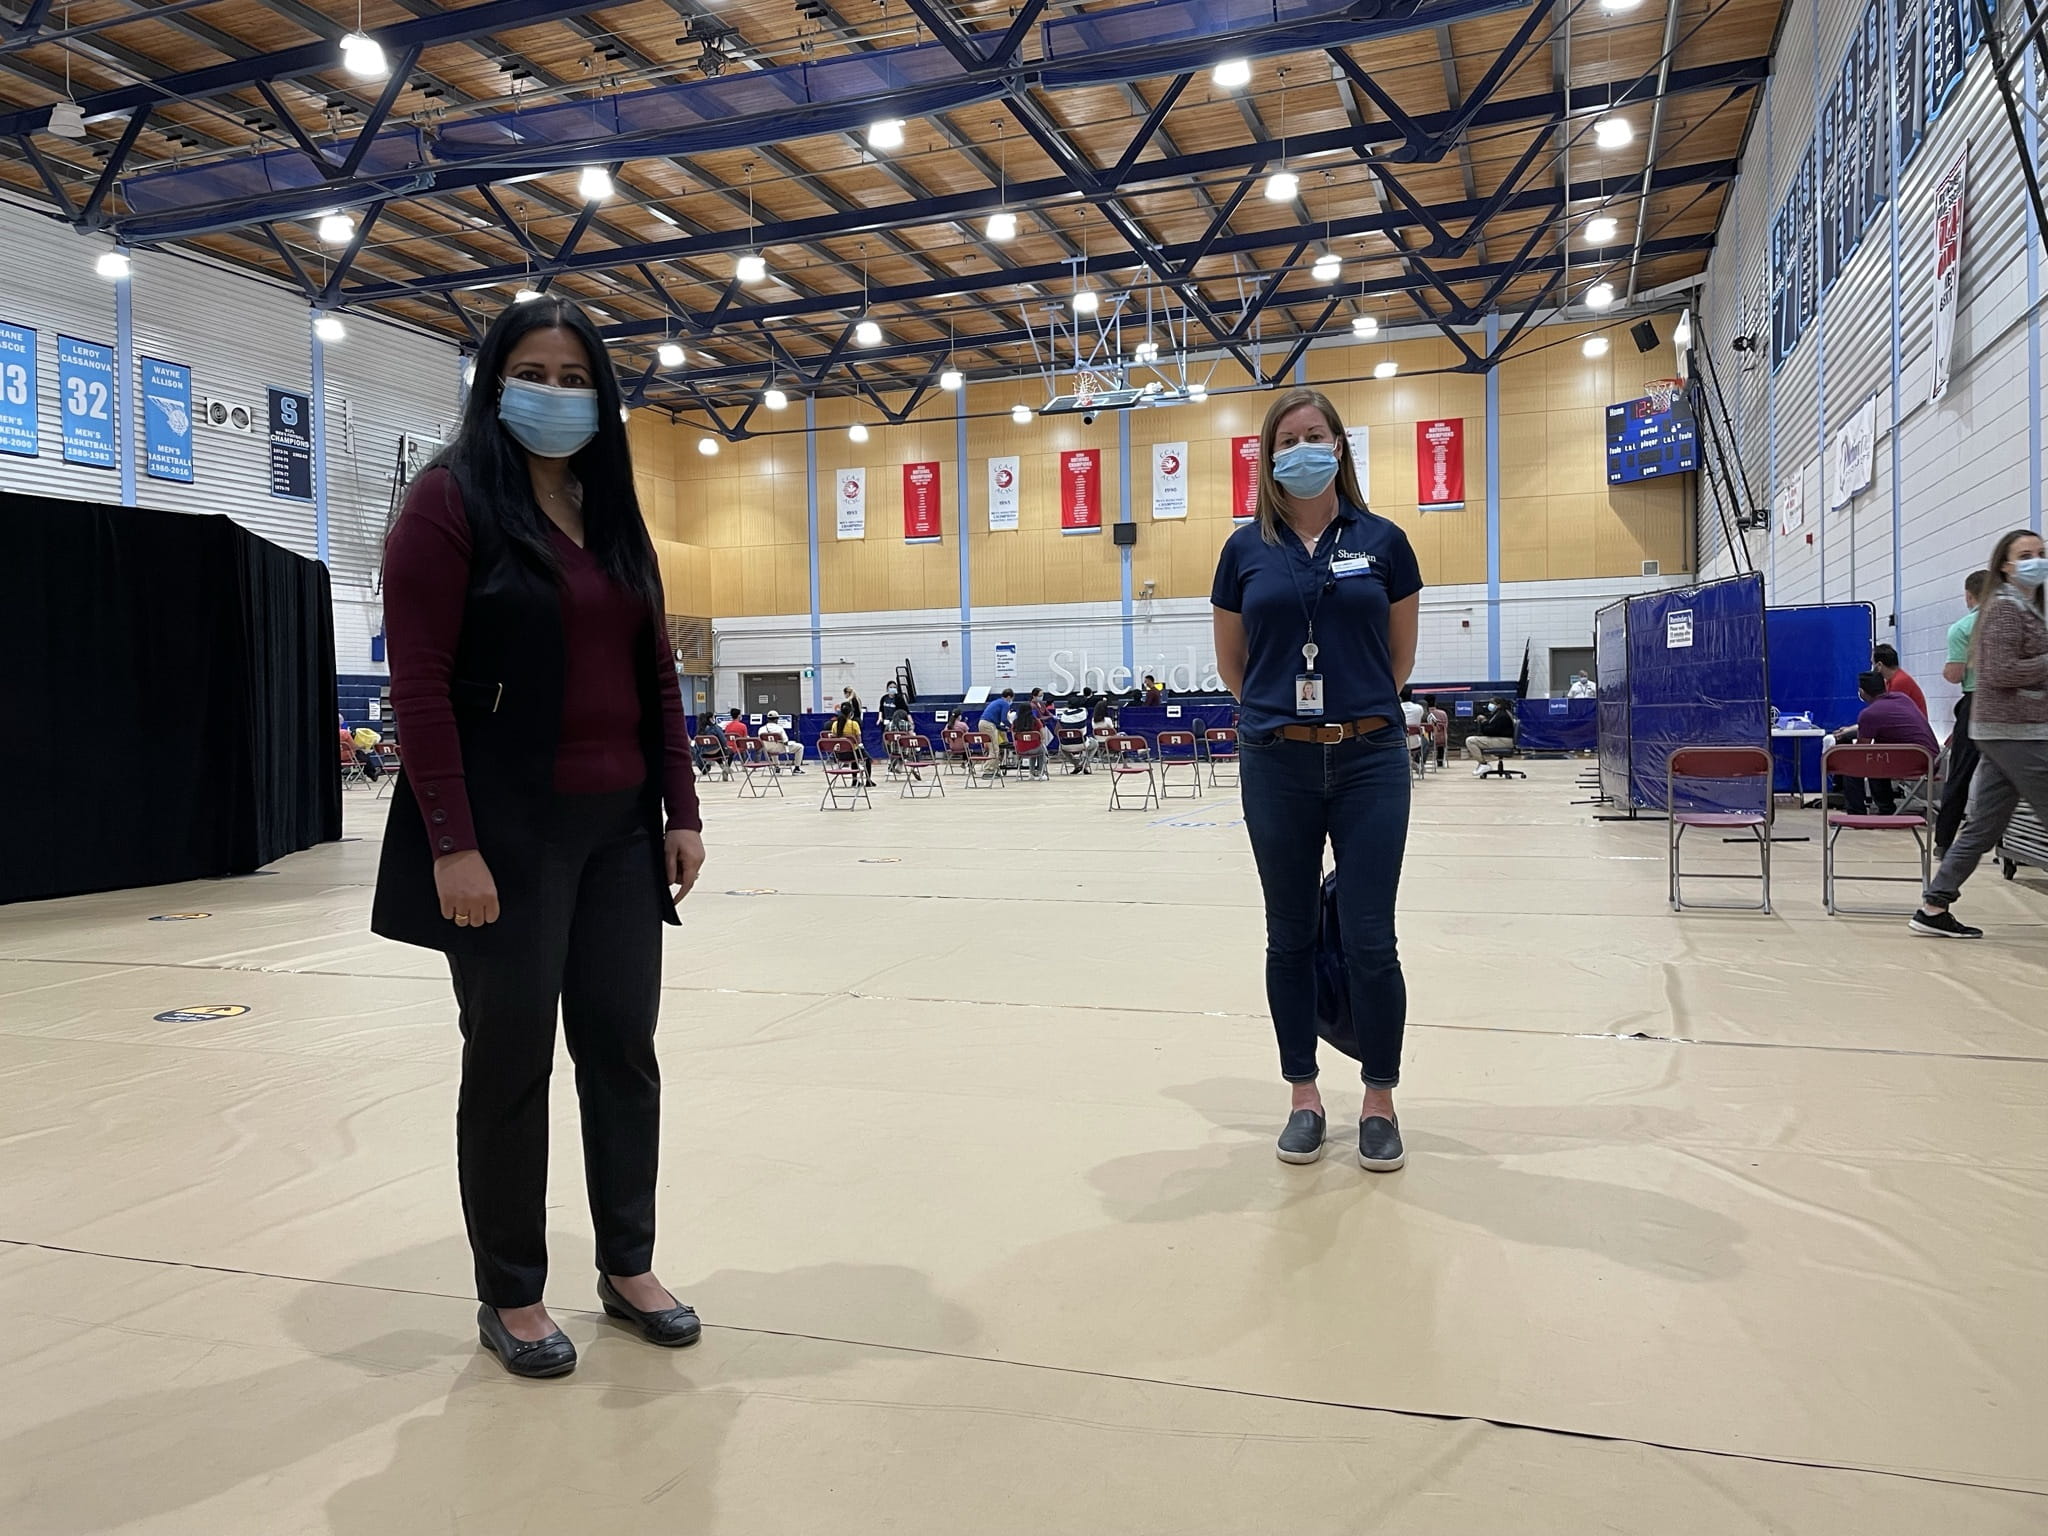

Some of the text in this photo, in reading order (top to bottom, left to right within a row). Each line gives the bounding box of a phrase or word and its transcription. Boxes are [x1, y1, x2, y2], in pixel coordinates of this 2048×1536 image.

[73, 346, 100, 358] LEROY
[62, 354, 112, 372] CASSANOVA
[154, 366, 180, 378] WAYNE
[0, 362, 28, 405] 13
[152, 376, 184, 390] ALLISON
[68, 376, 108, 420] 32
[281, 396, 298, 426] S
[75, 428, 101, 439] MEN'S
[64, 436, 112, 451] BASKETBALL
[270, 434, 310, 448] CHAMPIONS
[158, 444, 180, 455] MEN'S
[148, 453, 192, 466] BASKETBALL
[1338, 550, 1376, 562] Sheridan
[1047, 646, 1227, 697] Sherida
